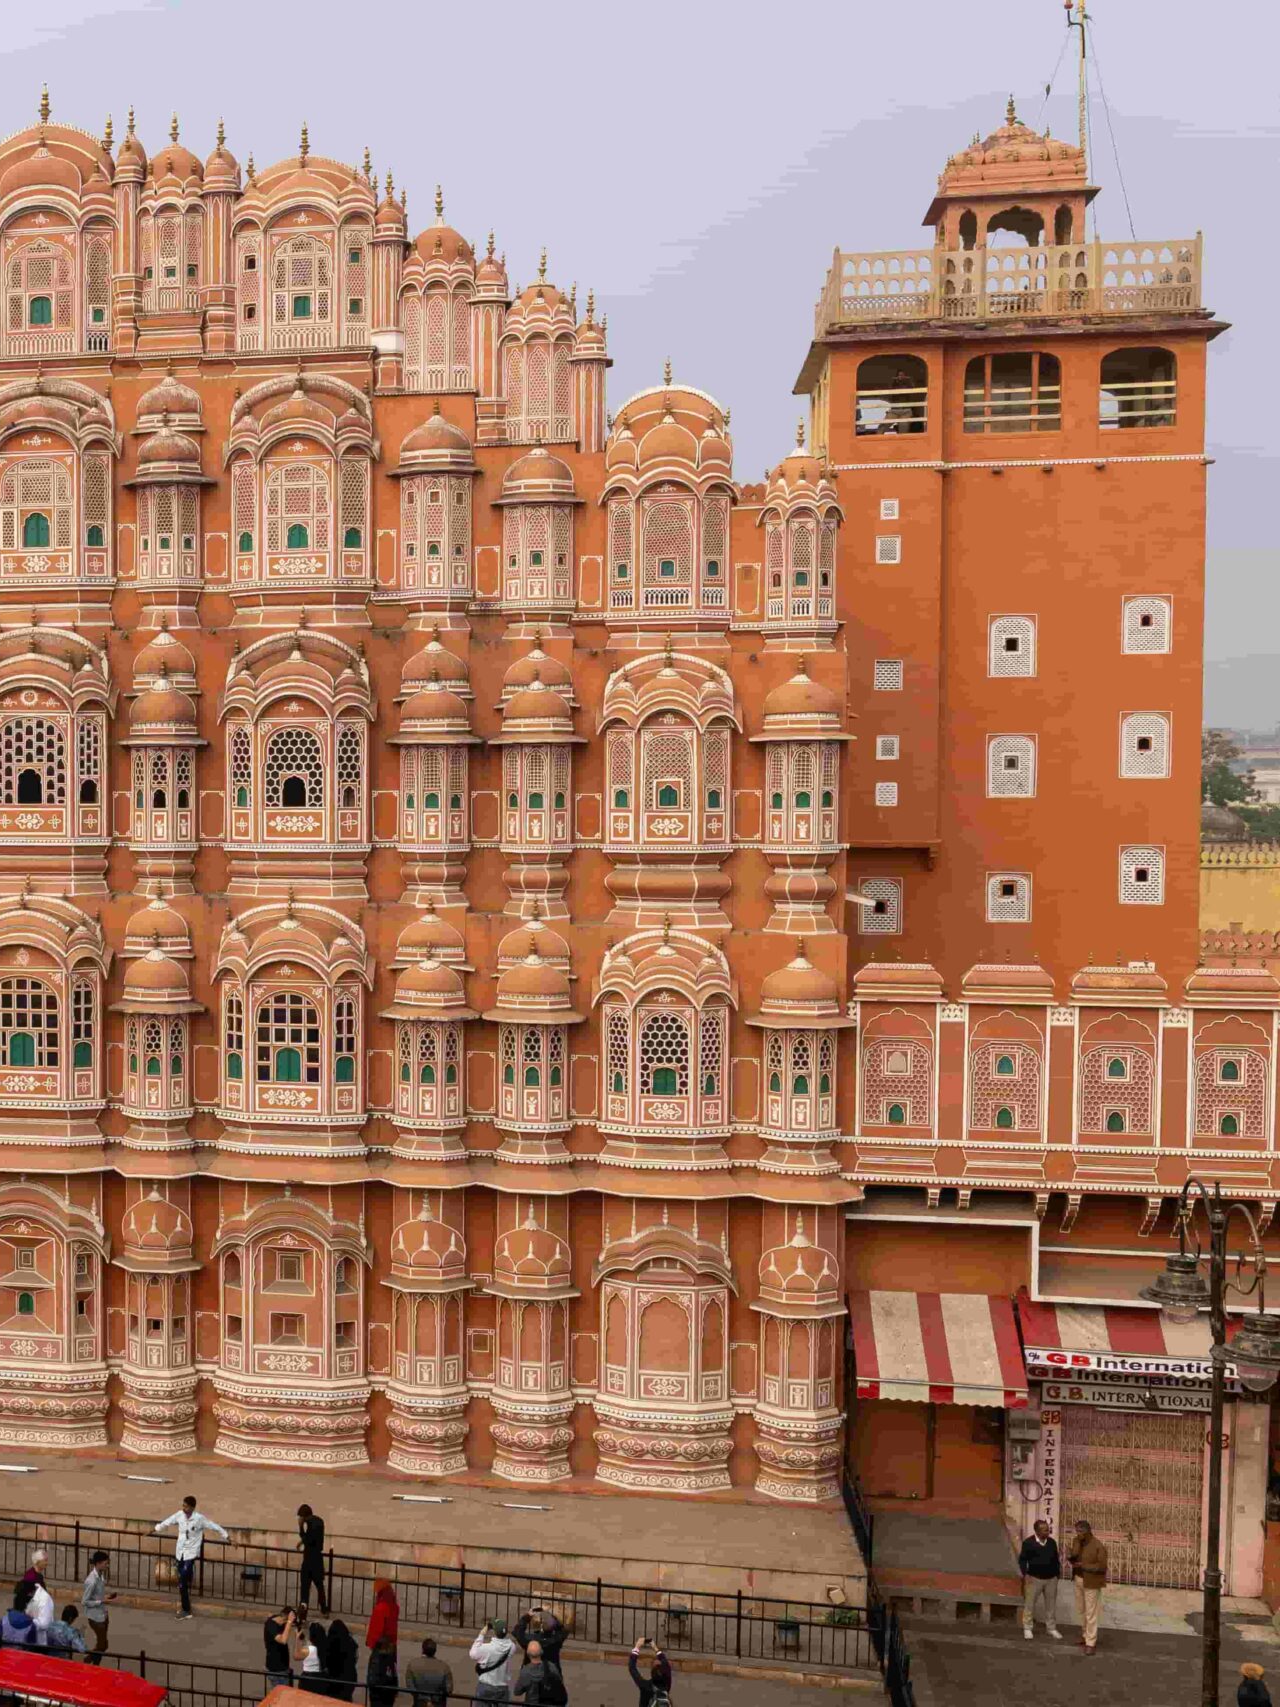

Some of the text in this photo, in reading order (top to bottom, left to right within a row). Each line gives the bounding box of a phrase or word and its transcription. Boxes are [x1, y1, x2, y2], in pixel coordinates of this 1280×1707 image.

[1046, 1352, 1092, 1367] GB
[1027, 1366, 1235, 1391] GB Internationl
[1046, 1385, 1089, 1401] G.B.
[1040, 1410, 1061, 1425] GB
[1206, 1431, 1230, 1449] B
